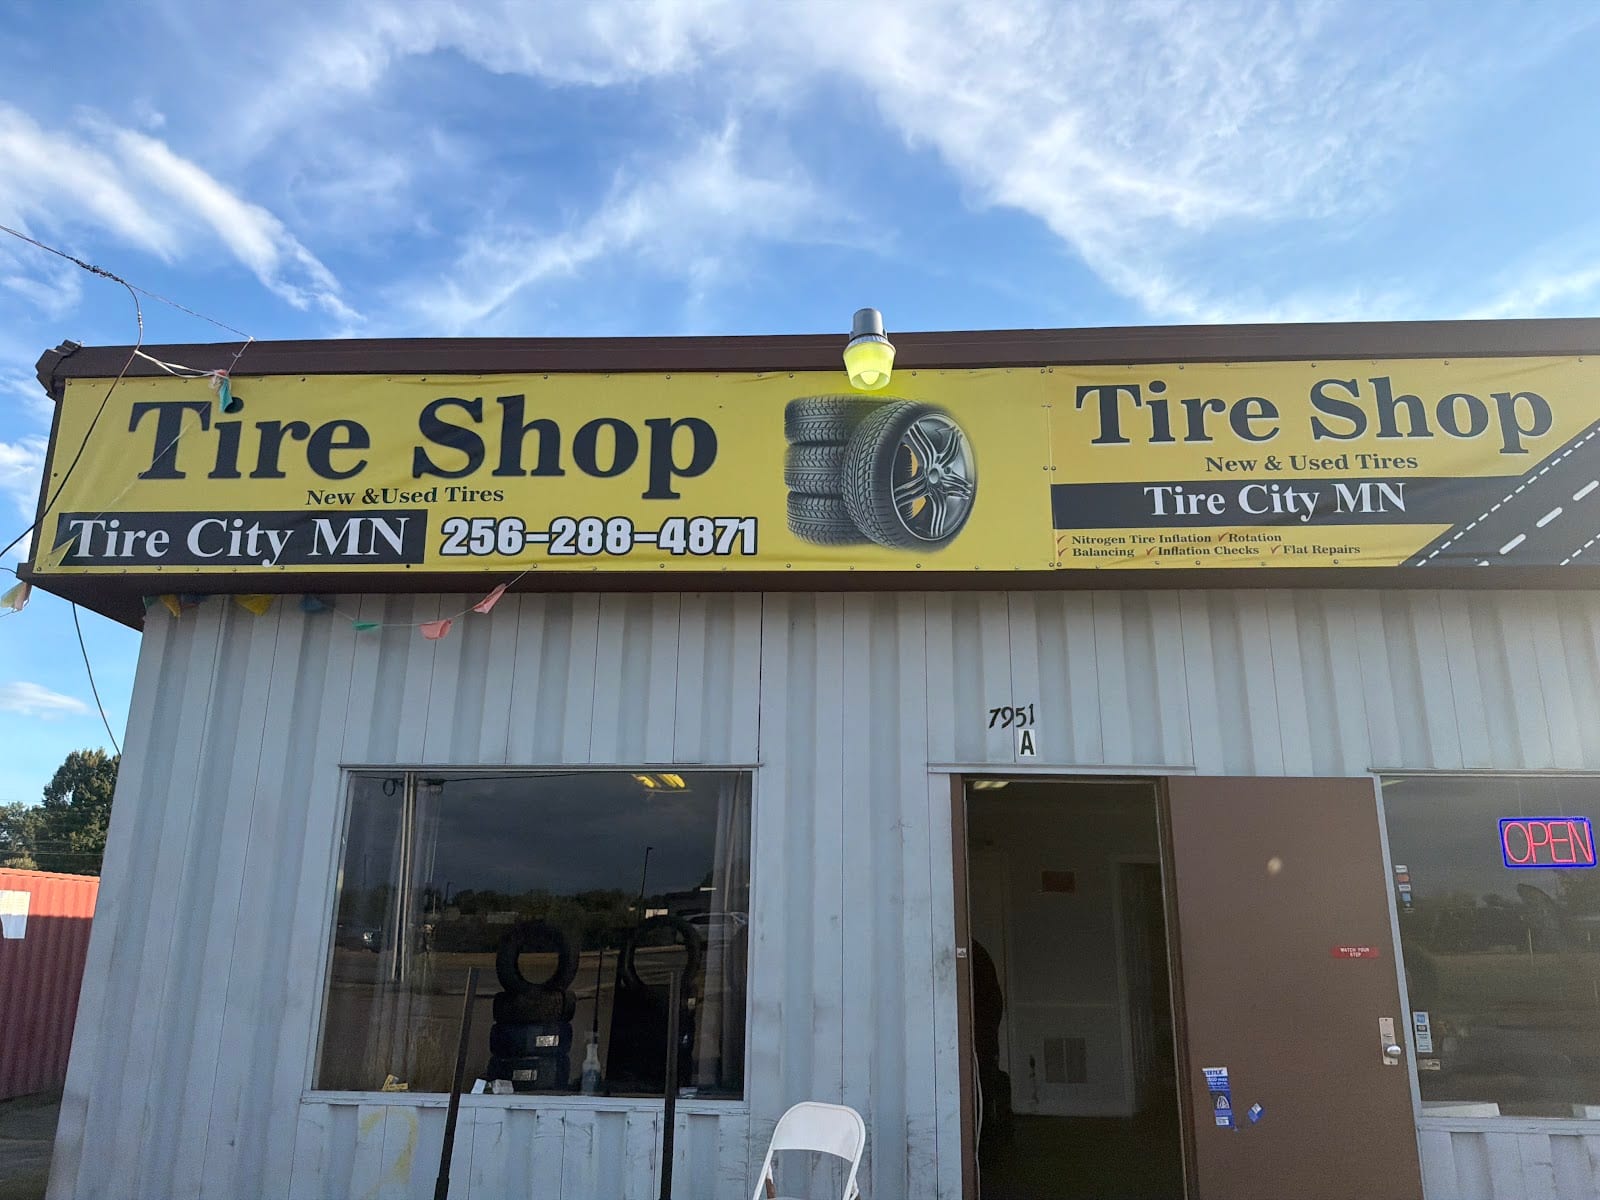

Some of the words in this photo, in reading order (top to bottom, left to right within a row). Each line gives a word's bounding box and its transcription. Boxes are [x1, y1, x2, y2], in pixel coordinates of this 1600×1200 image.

[1075, 380, 1280, 445] Tire
[1309, 376, 1553, 454] Shop
[128, 396, 371, 481] Tire
[412, 394, 719, 500] Shop
[1205, 456, 1258, 473] New
[1264, 456, 1283, 473] &
[1291, 454, 1349, 471] Used
[1355, 453, 1419, 470] Tires
[306, 488, 355, 506] New
[444, 485, 505, 503] Tires
[1143, 485, 1226, 517] Tire
[1238, 483, 1320, 521] City
[1333, 482, 1406, 514] MN
[67, 518, 170, 559] Tire
[186, 517, 294, 567] City
[306, 516, 410, 557] MN
[439, 516, 759, 557] 256-288-4871
[1071, 534, 1126, 545] Nitrogen
[1128, 534, 1155, 544] Tire
[1158, 532, 1212, 543] Inflation
[1228, 531, 1282, 543] Rotation
[1072, 546, 1135, 559] Balancing
[1157, 545, 1211, 556] Inflation
[1214, 545, 1260, 555] Checks
[1283, 543, 1311, 554] Flat
[1312, 543, 1361, 555] Repairs
[988, 703, 1035, 728] 7951
[1020, 730, 1035, 755] A
[1503, 821, 1593, 863] OPEN
